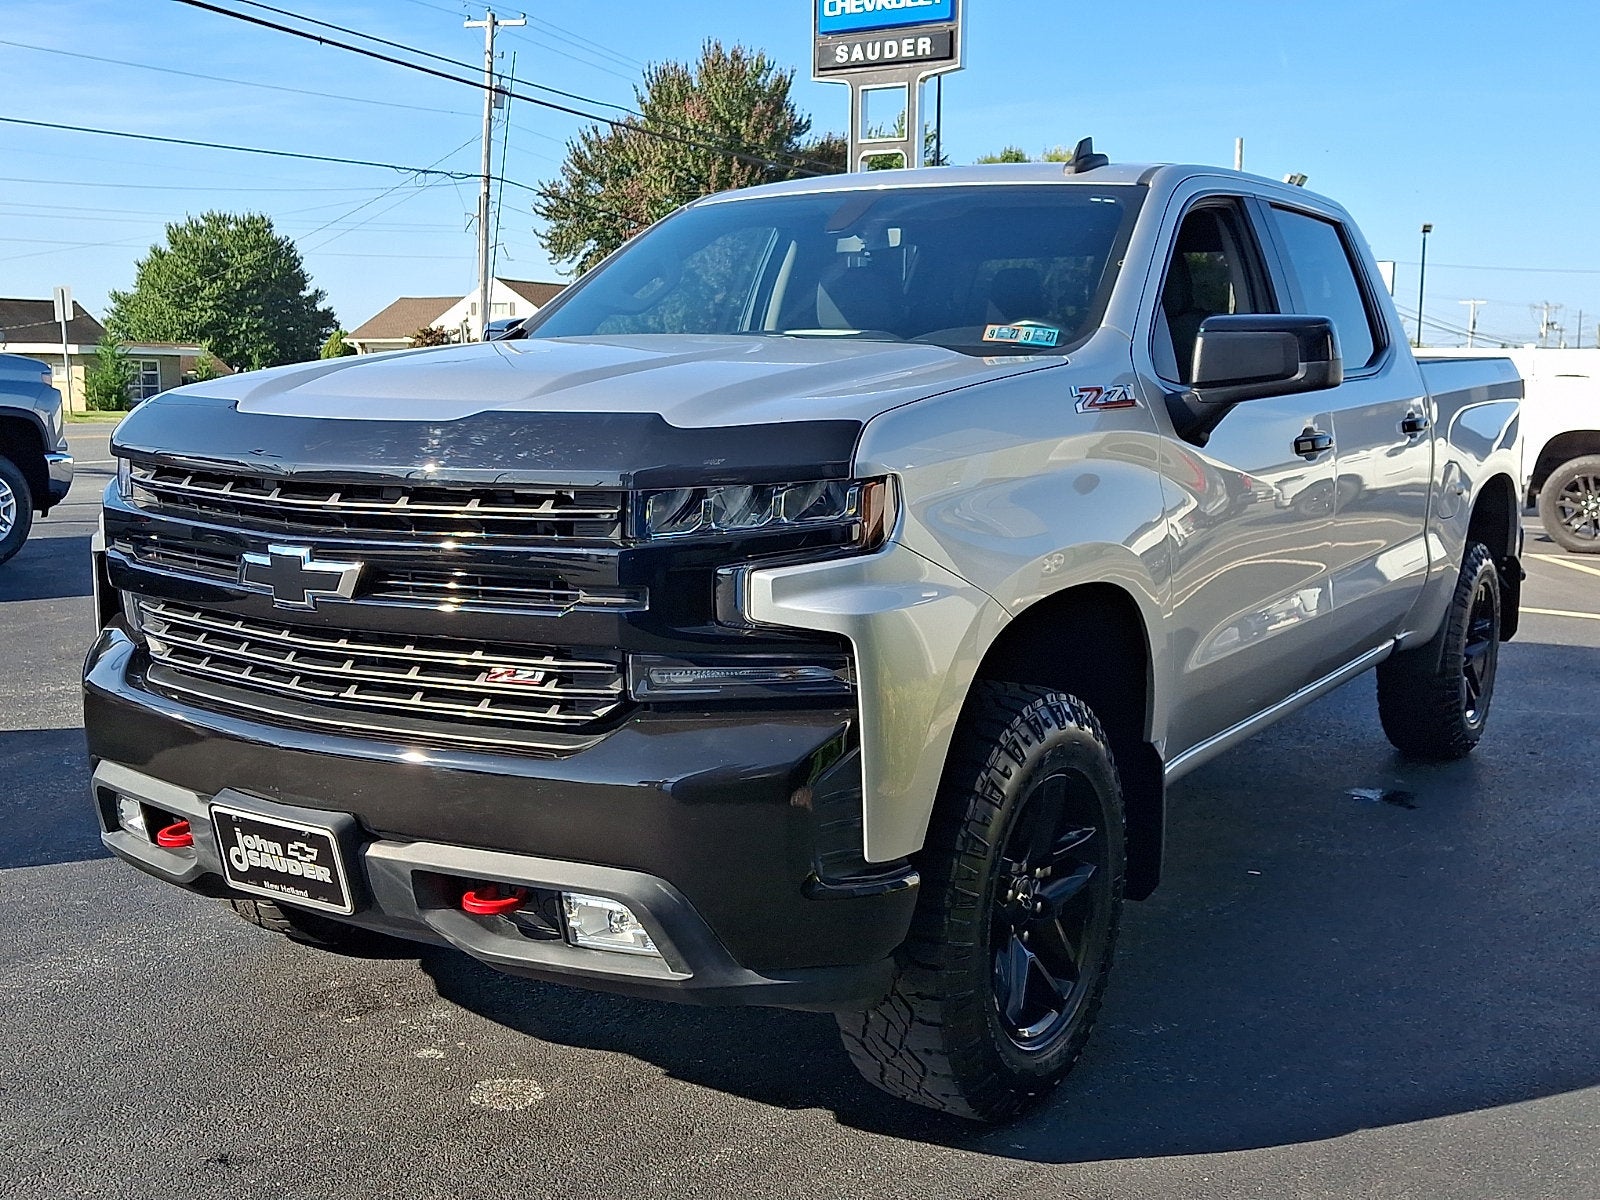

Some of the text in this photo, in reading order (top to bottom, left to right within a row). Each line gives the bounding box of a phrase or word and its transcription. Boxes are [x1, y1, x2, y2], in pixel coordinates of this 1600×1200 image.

[835, 37, 932, 63] SAUDER
[247, 850, 334, 884] SAUDER
[263, 880, 309, 898] New Holland
